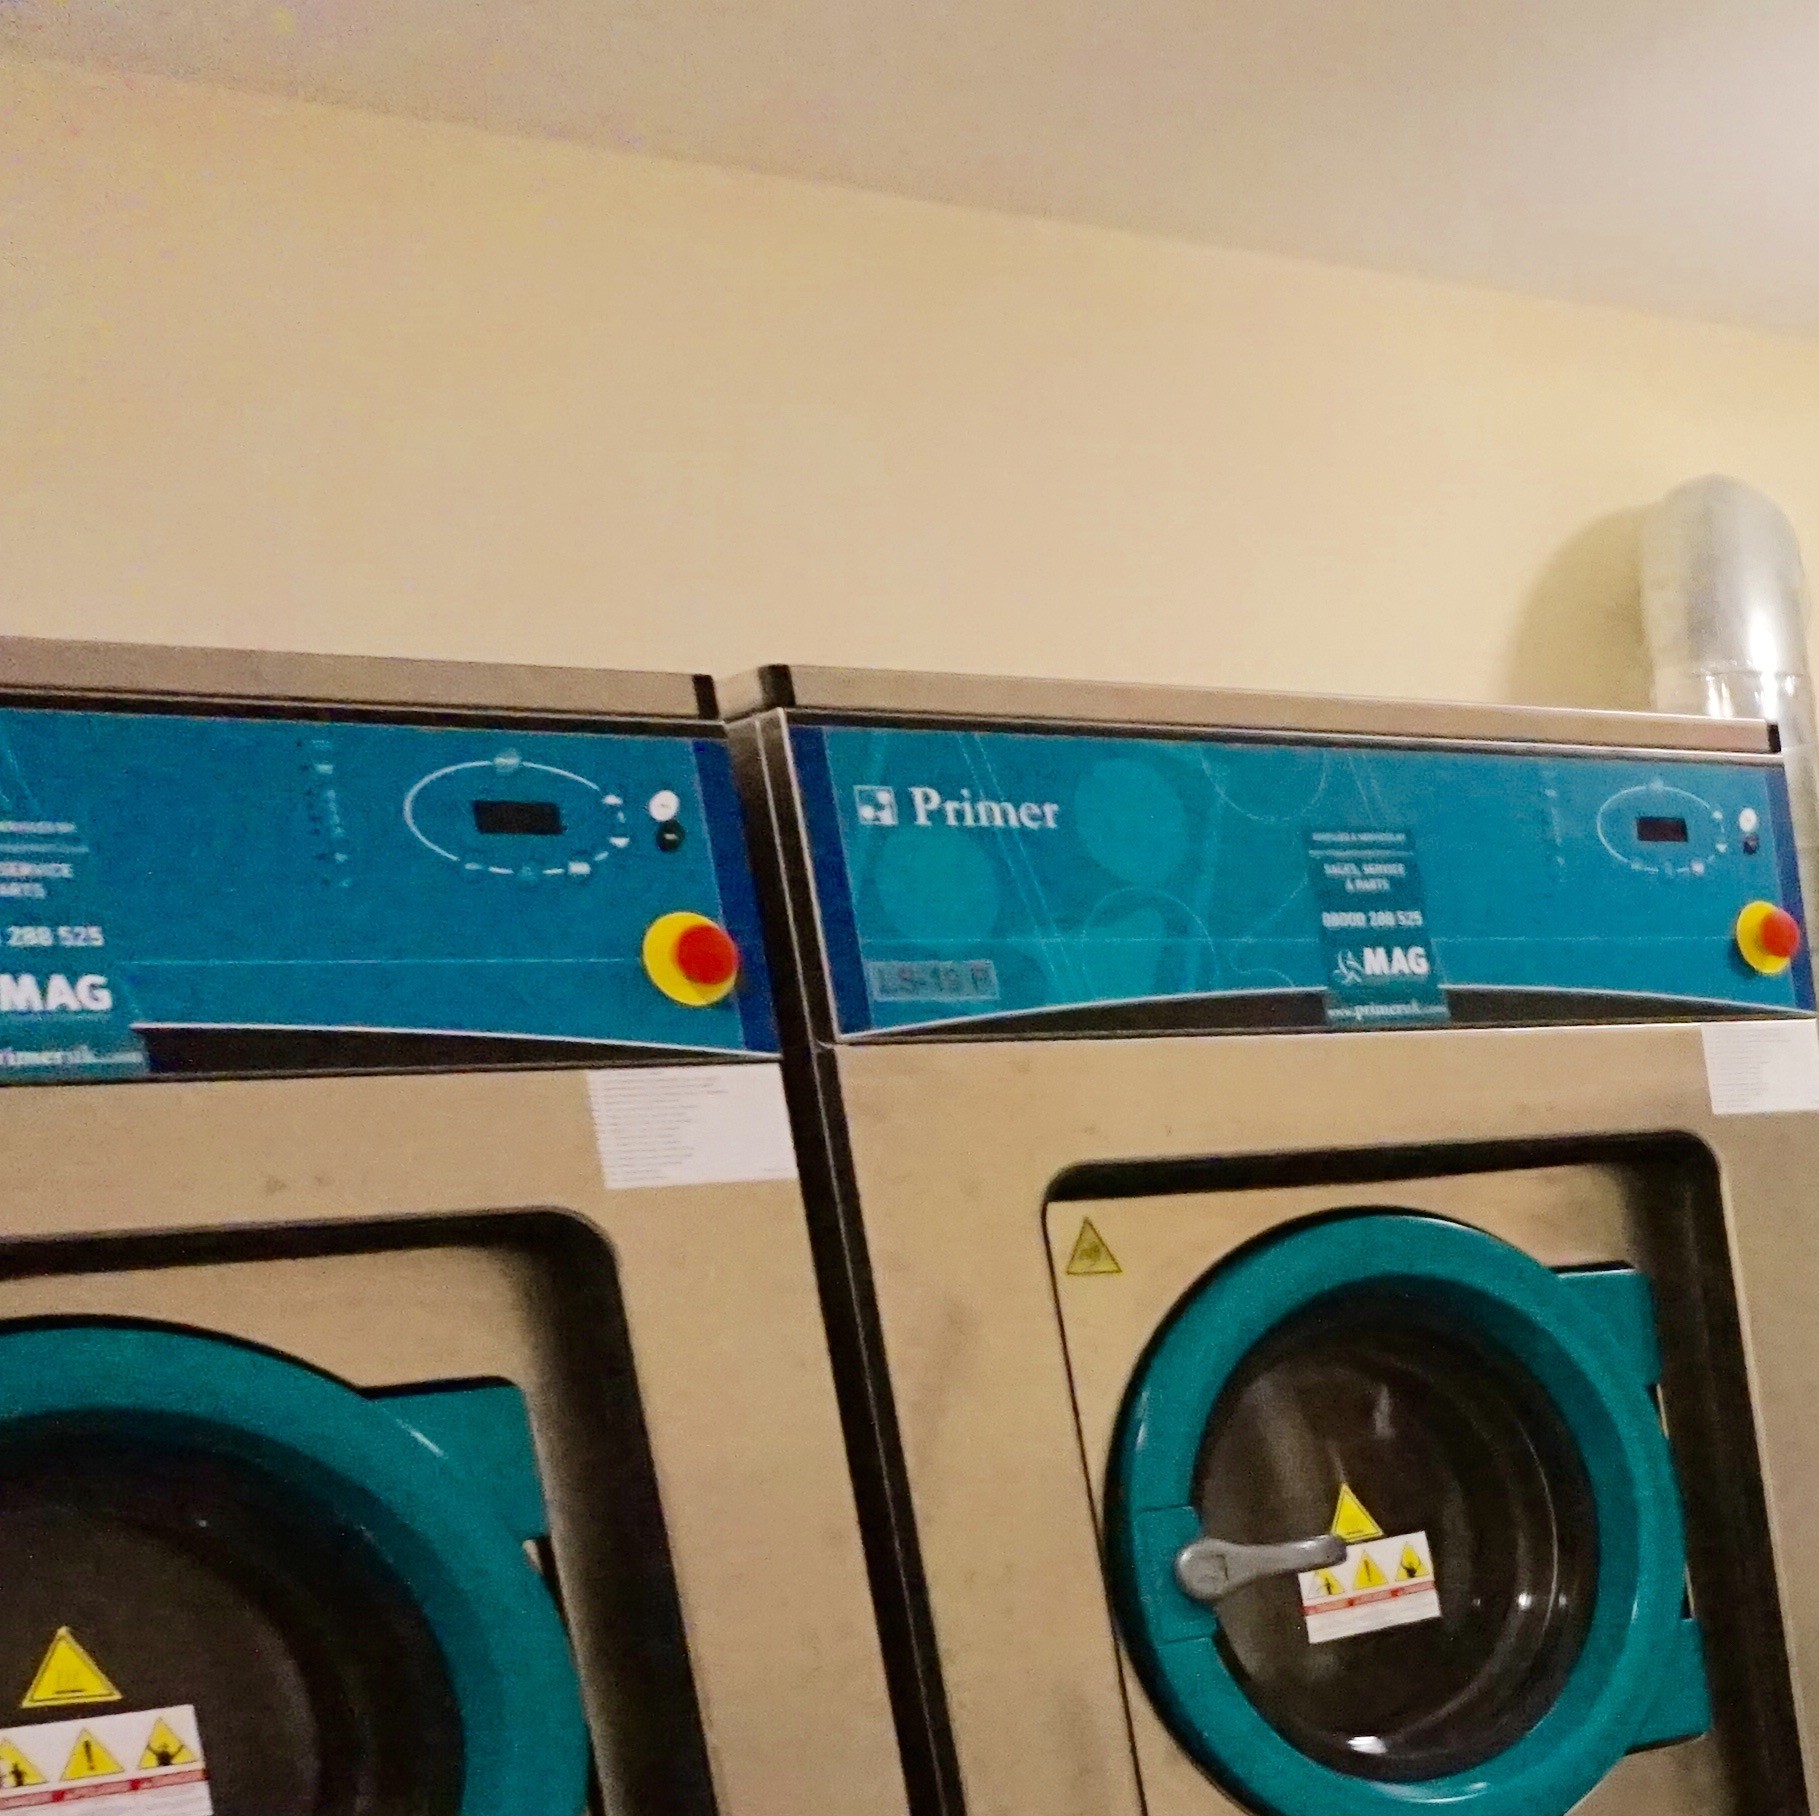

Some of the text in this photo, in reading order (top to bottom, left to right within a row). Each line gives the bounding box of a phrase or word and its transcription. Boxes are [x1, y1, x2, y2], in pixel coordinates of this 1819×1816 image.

[908, 786, 1059, 830] Primer
[1396, 911, 1424, 928] 525
[57, 926, 105, 947] 525
[1362, 946, 1431, 975] MAG
[0, 974, 113, 1012] MAG
